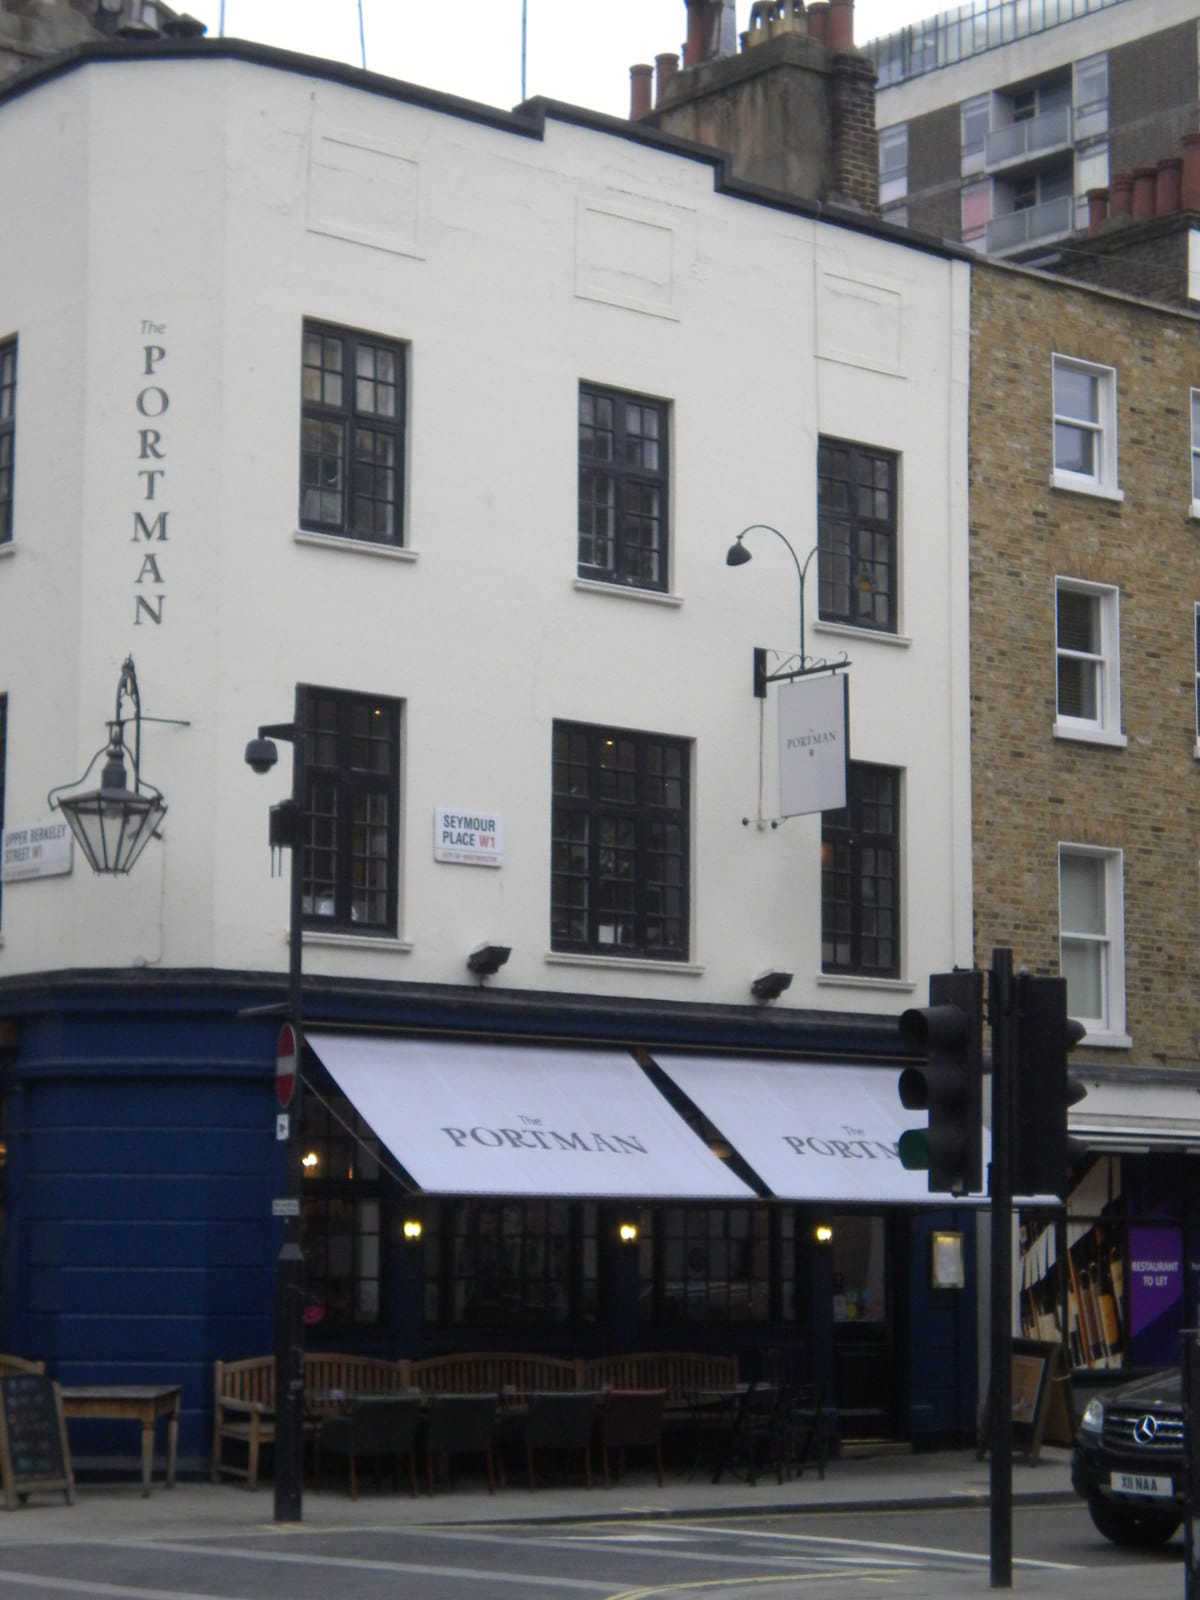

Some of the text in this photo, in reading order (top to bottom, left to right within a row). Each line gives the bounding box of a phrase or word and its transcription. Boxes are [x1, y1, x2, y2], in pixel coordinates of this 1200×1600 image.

[141, 319, 166, 335] The
[131, 345, 170, 625] PORTMAN
[786, 730, 837, 750] PORTMAN
[443, 814, 496, 832] SEYMOUR
[442, 830, 496, 849] PLACE W1
[518, 1114, 543, 1126] The
[440, 1127, 649, 1154] PORTMAN
[782, 1136, 900, 1159] PORTM
[1131, 1261, 1179, 1272] RESTAURANT
[1143, 1275, 1168, 1287] TO LET
